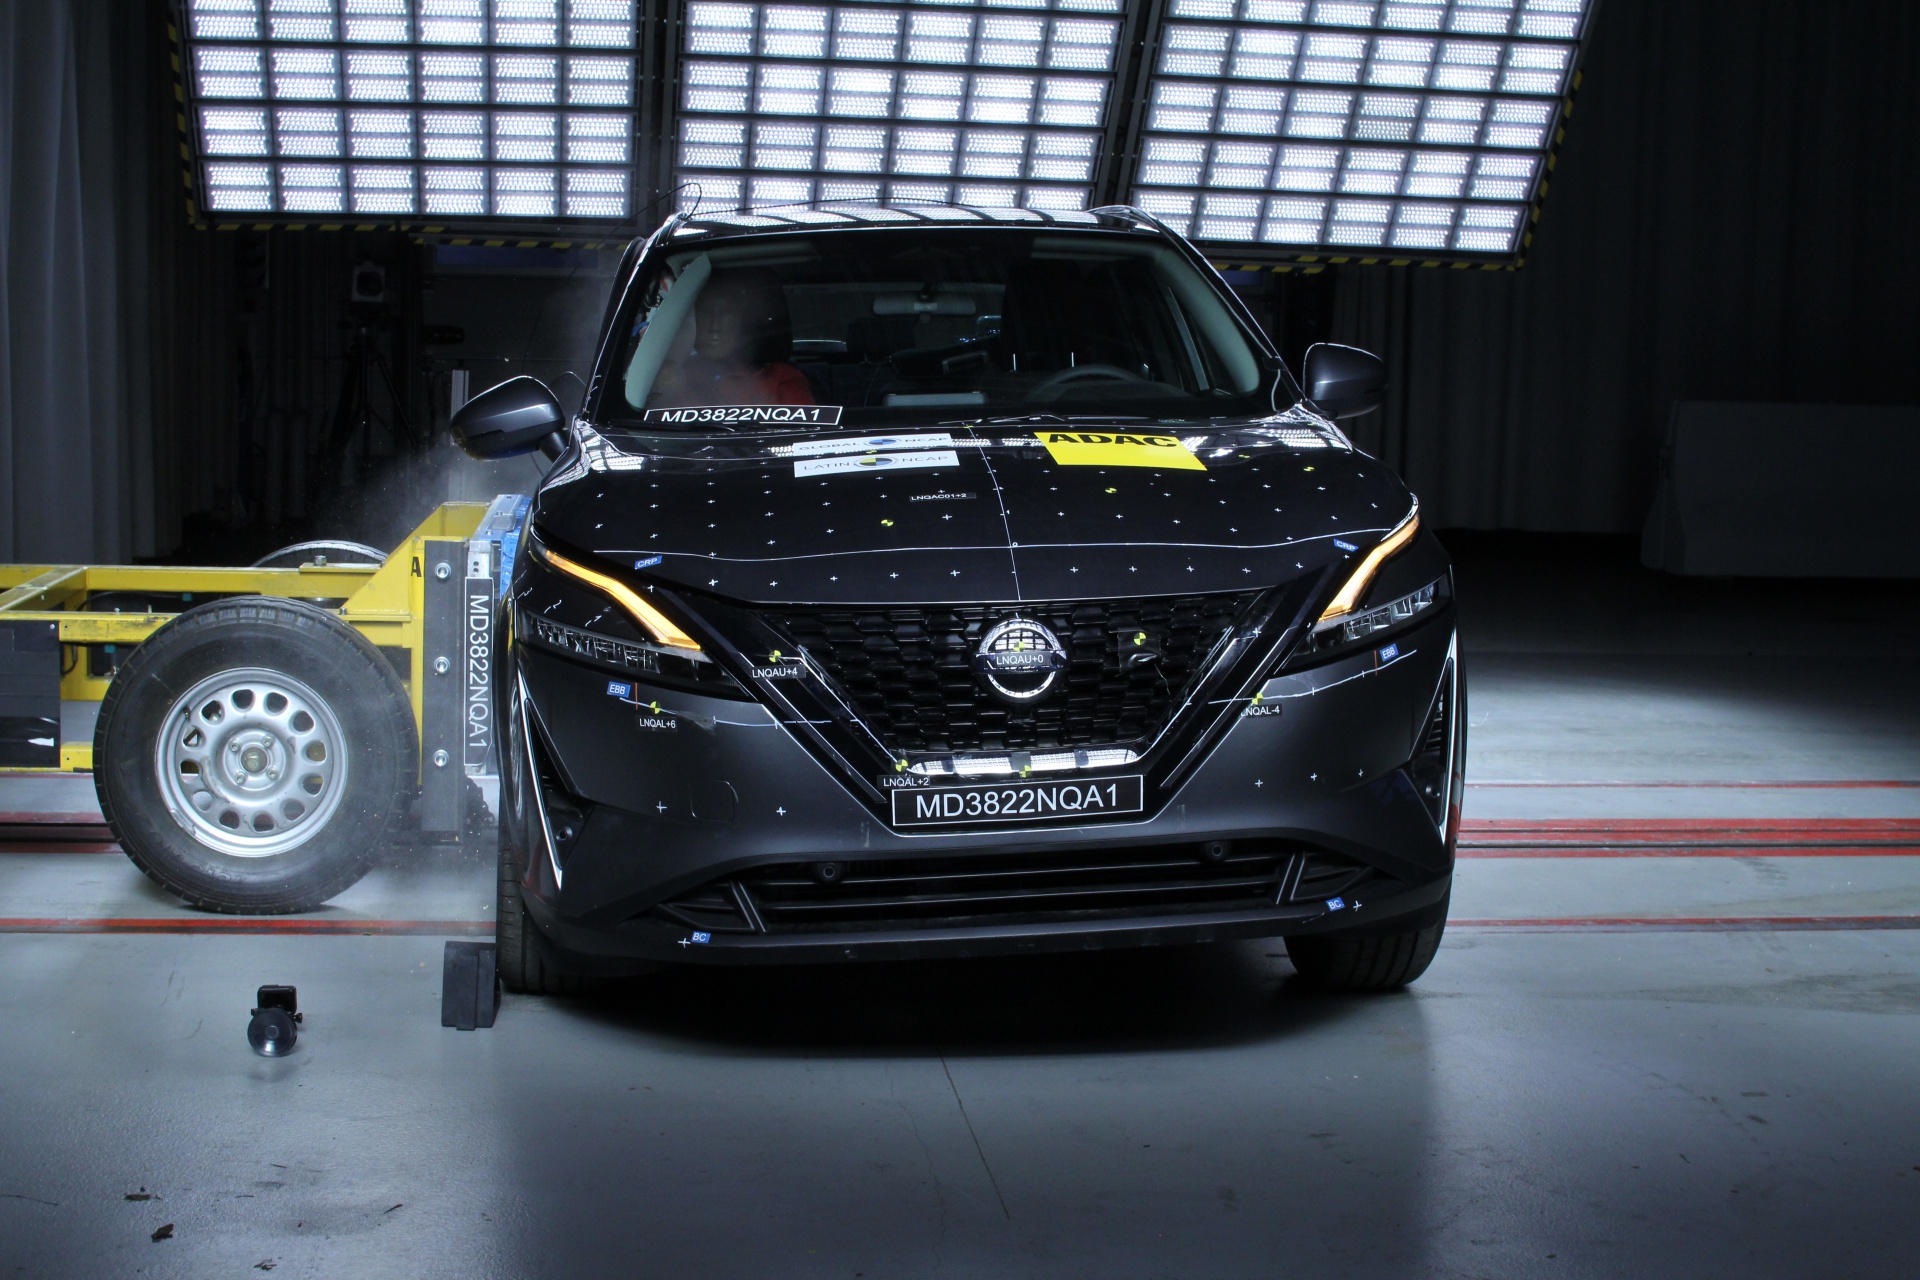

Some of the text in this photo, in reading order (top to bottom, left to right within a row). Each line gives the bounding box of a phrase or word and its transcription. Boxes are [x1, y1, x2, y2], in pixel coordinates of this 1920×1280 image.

[661, 408, 820, 422] MD3822NQA1
[1048, 433, 1177, 447] ADAC
[799, 442, 861, 450] GLOBAL
[804, 462, 850, 470] LATIN
[1336, 540, 1356, 551] CRP
[411, 556, 422, 577] A
[637, 557, 658, 567] CRP
[1382, 646, 1396, 659] EBB
[996, 654, 1044, 665] LNQAU+0
[469, 595, 489, 747] MD3822NQA1
[752, 667, 798, 678] LNQAU+4
[609, 684, 626, 694] EBB
[639, 718, 676, 728] LNQAL+6
[883, 777, 929, 787] LNQAL+2
[916, 783, 1117, 818] MD3822NQA1
[1328, 900, 1342, 909] BC
[692, 932, 707, 942] BC
